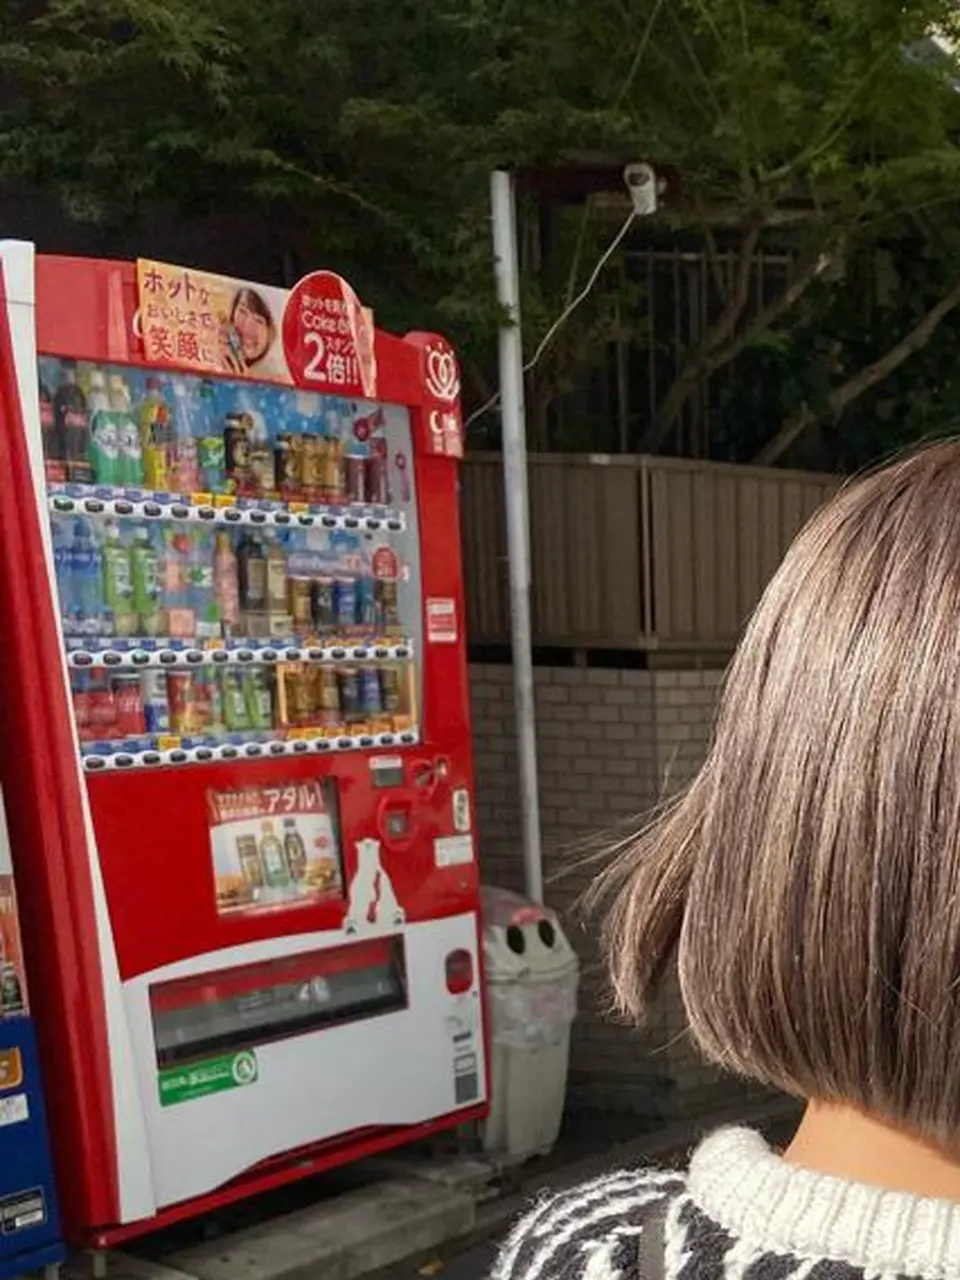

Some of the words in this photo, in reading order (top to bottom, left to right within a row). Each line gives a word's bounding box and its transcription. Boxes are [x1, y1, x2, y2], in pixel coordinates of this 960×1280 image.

[144, 268, 209, 305] ホットな
[301, 310, 336, 333] Coke
[150, 324, 217, 363] 笑顔に
